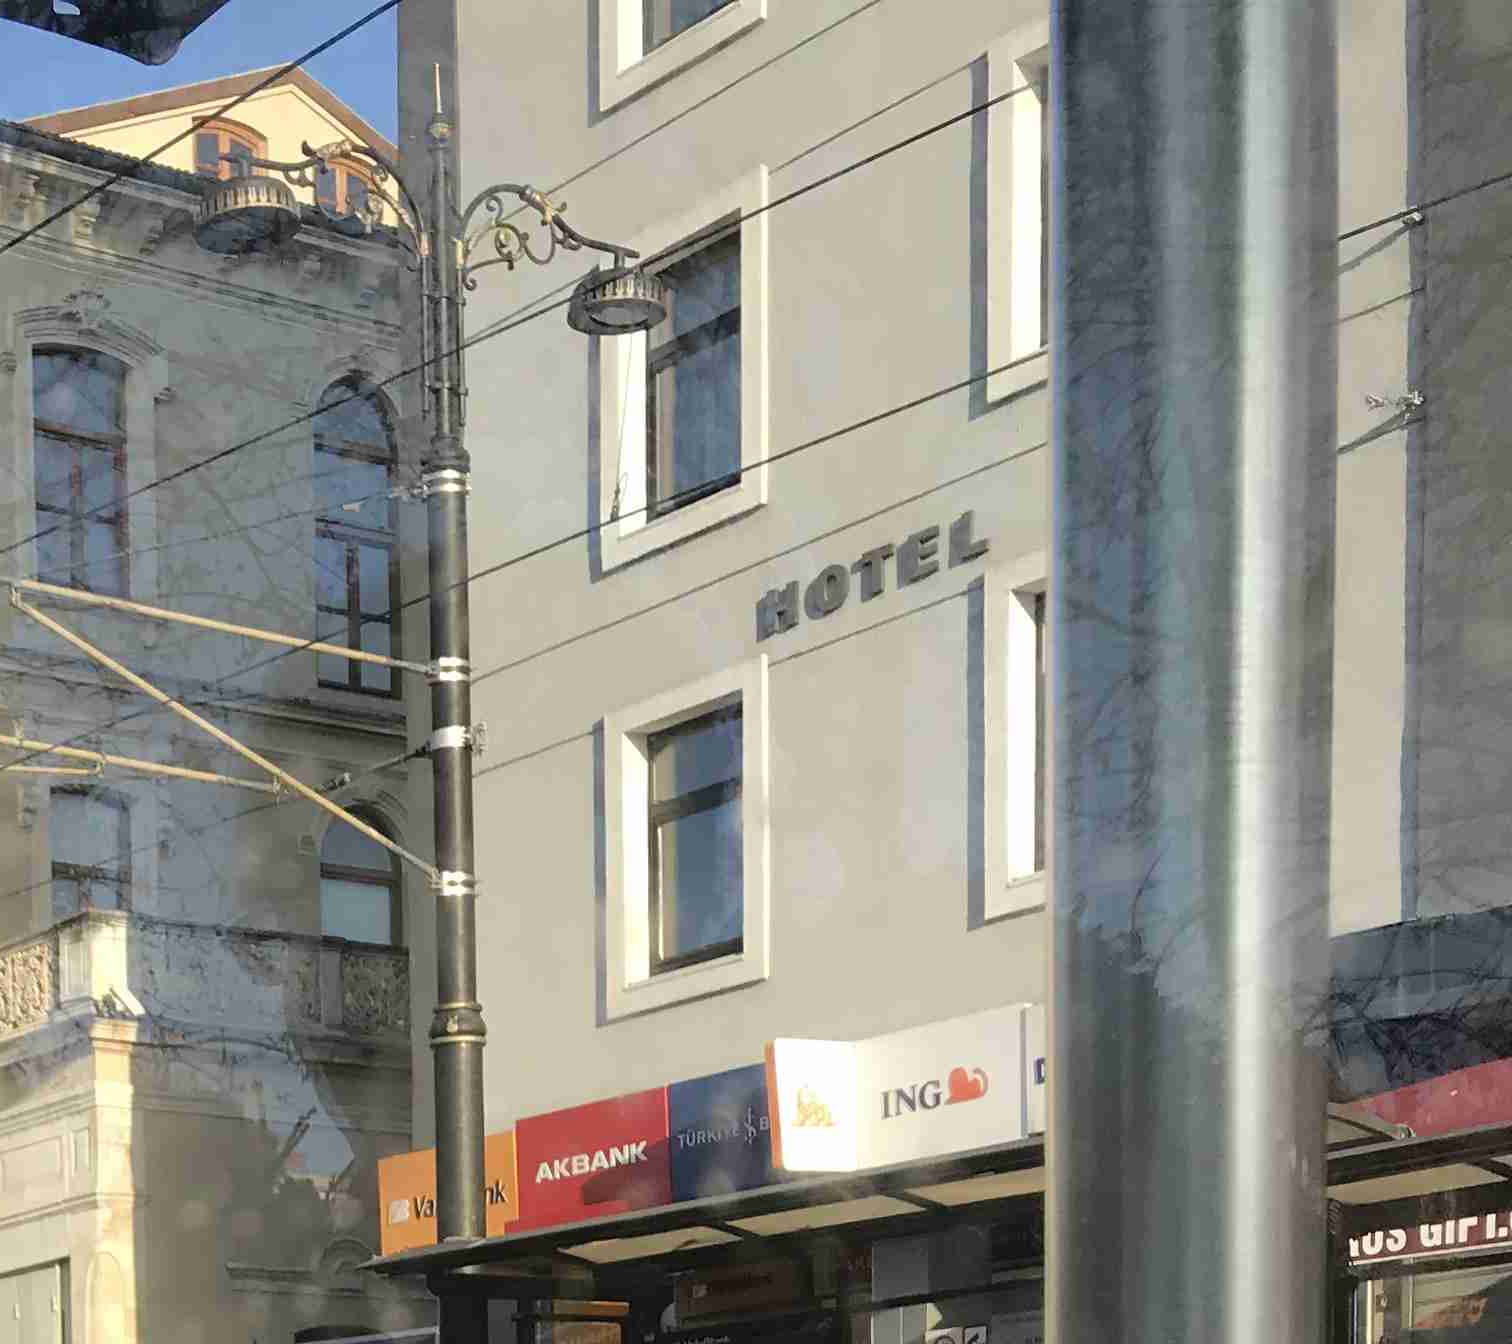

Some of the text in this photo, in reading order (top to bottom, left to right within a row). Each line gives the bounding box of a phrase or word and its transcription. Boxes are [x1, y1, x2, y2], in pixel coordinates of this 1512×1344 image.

[755, 510, 990, 642] HOTEL
[881, 1079, 942, 1120] ING
[536, 1140, 648, 1183] AKBANK
